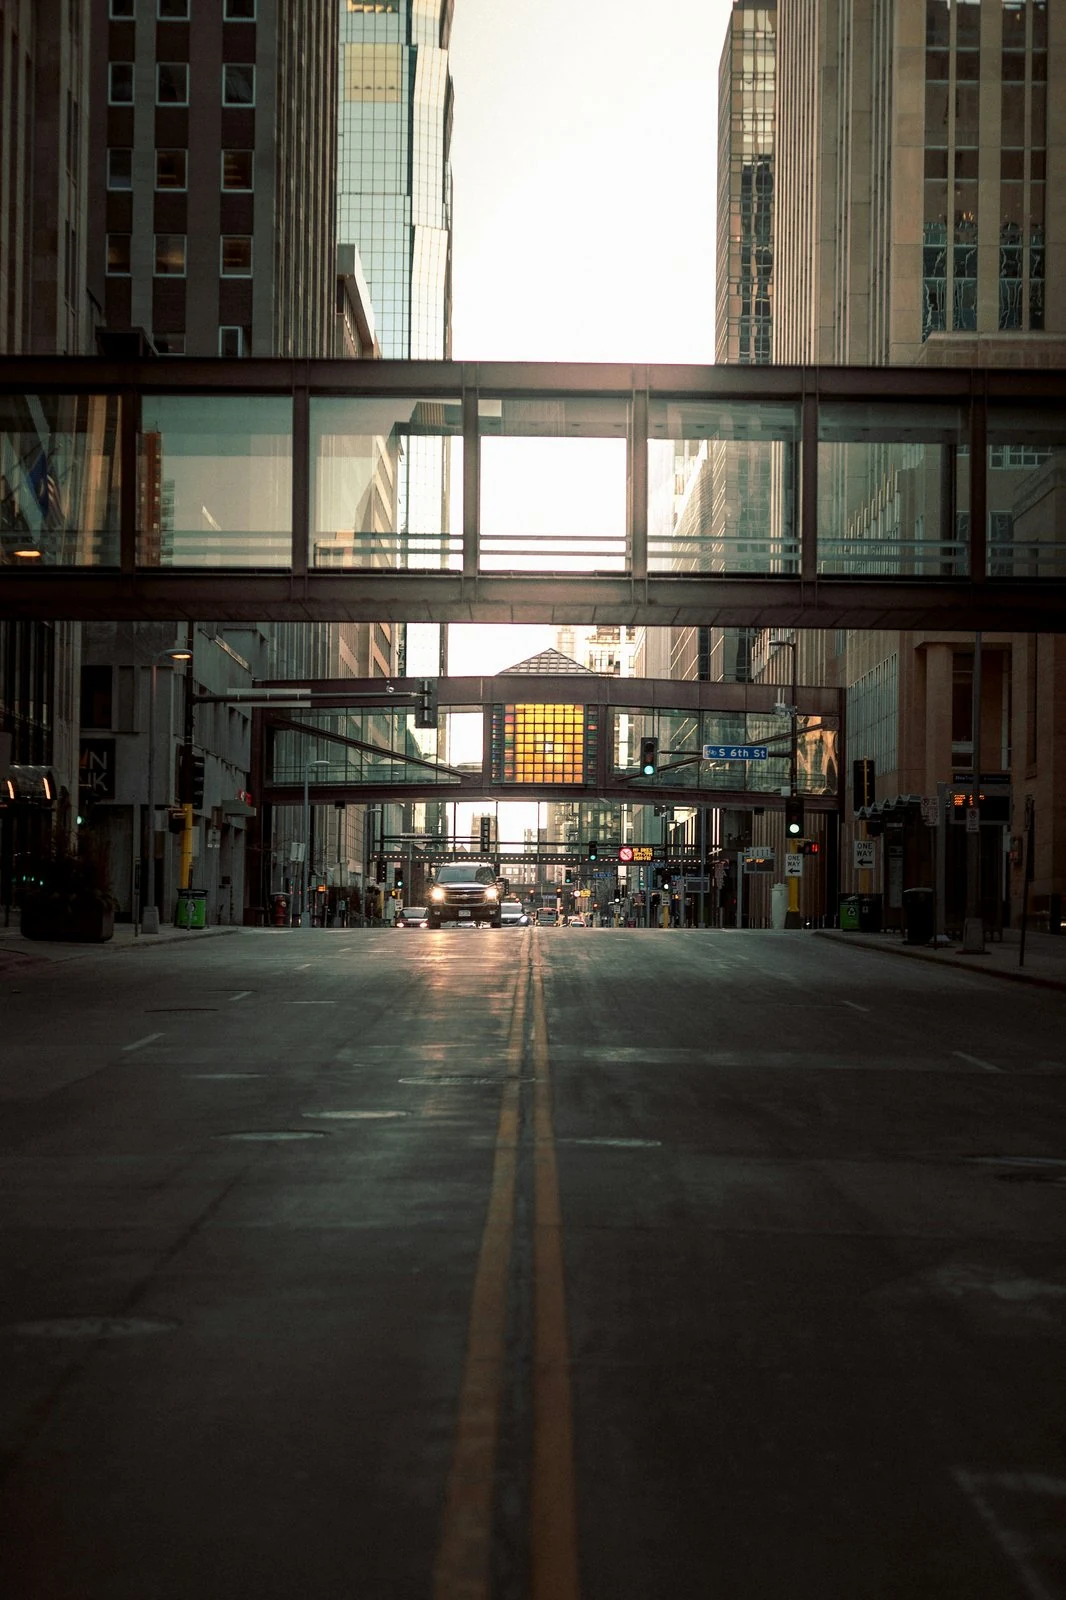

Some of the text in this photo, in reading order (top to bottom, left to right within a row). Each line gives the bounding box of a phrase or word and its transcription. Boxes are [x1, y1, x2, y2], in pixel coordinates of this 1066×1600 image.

[718, 748, 765, 758] S 6th St
